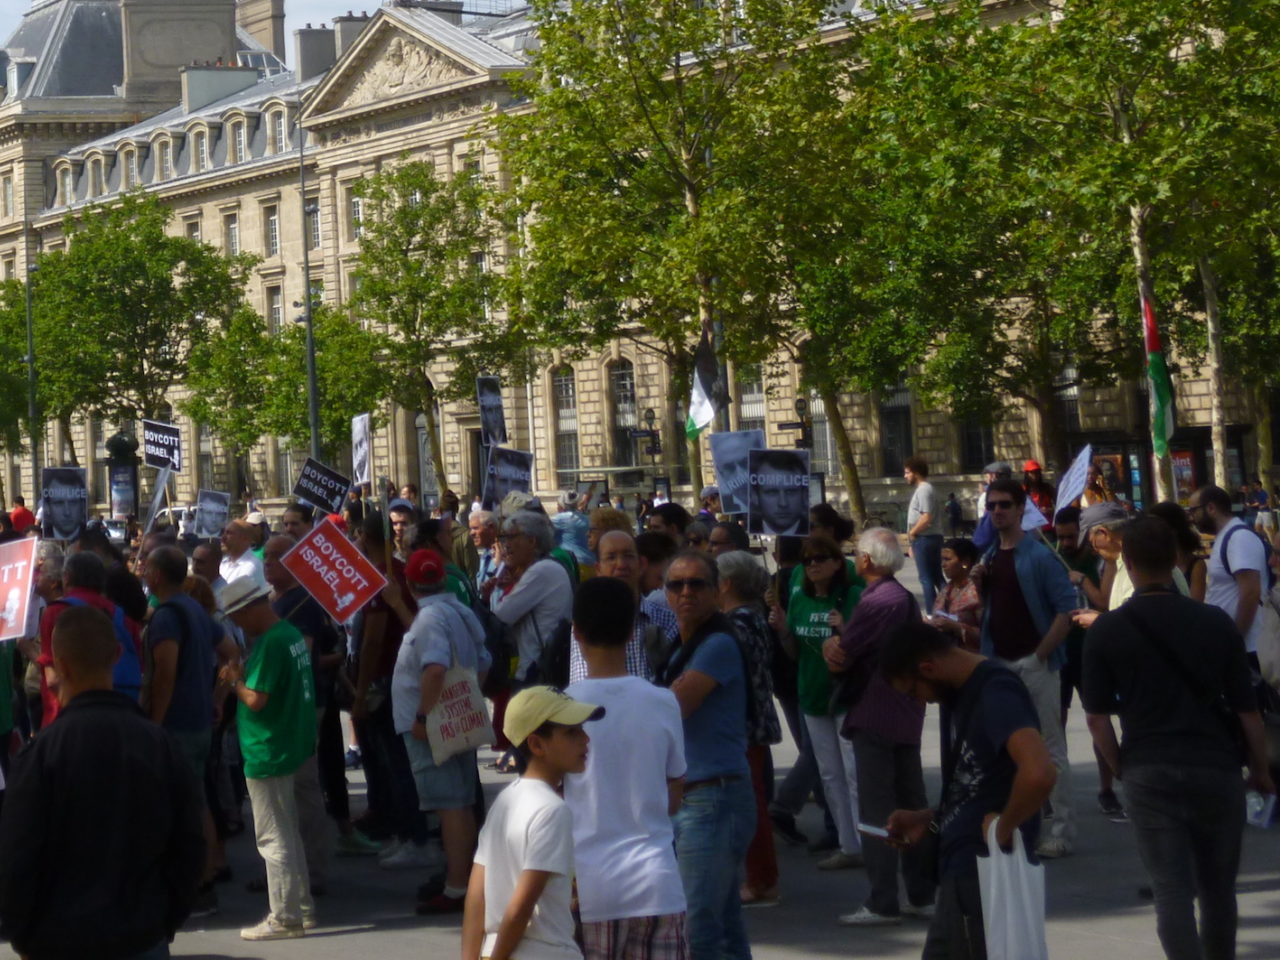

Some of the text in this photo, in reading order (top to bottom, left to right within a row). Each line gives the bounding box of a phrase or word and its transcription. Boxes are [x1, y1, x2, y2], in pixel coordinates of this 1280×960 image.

[144, 430, 179, 446] BOYCOTT
[304, 465, 347, 494] BOYCOTT
[750, 473, 809, 486] COMPLICE
[42, 487, 87, 498] COMPLICE
[312, 533, 368, 591] BOYCOTT
